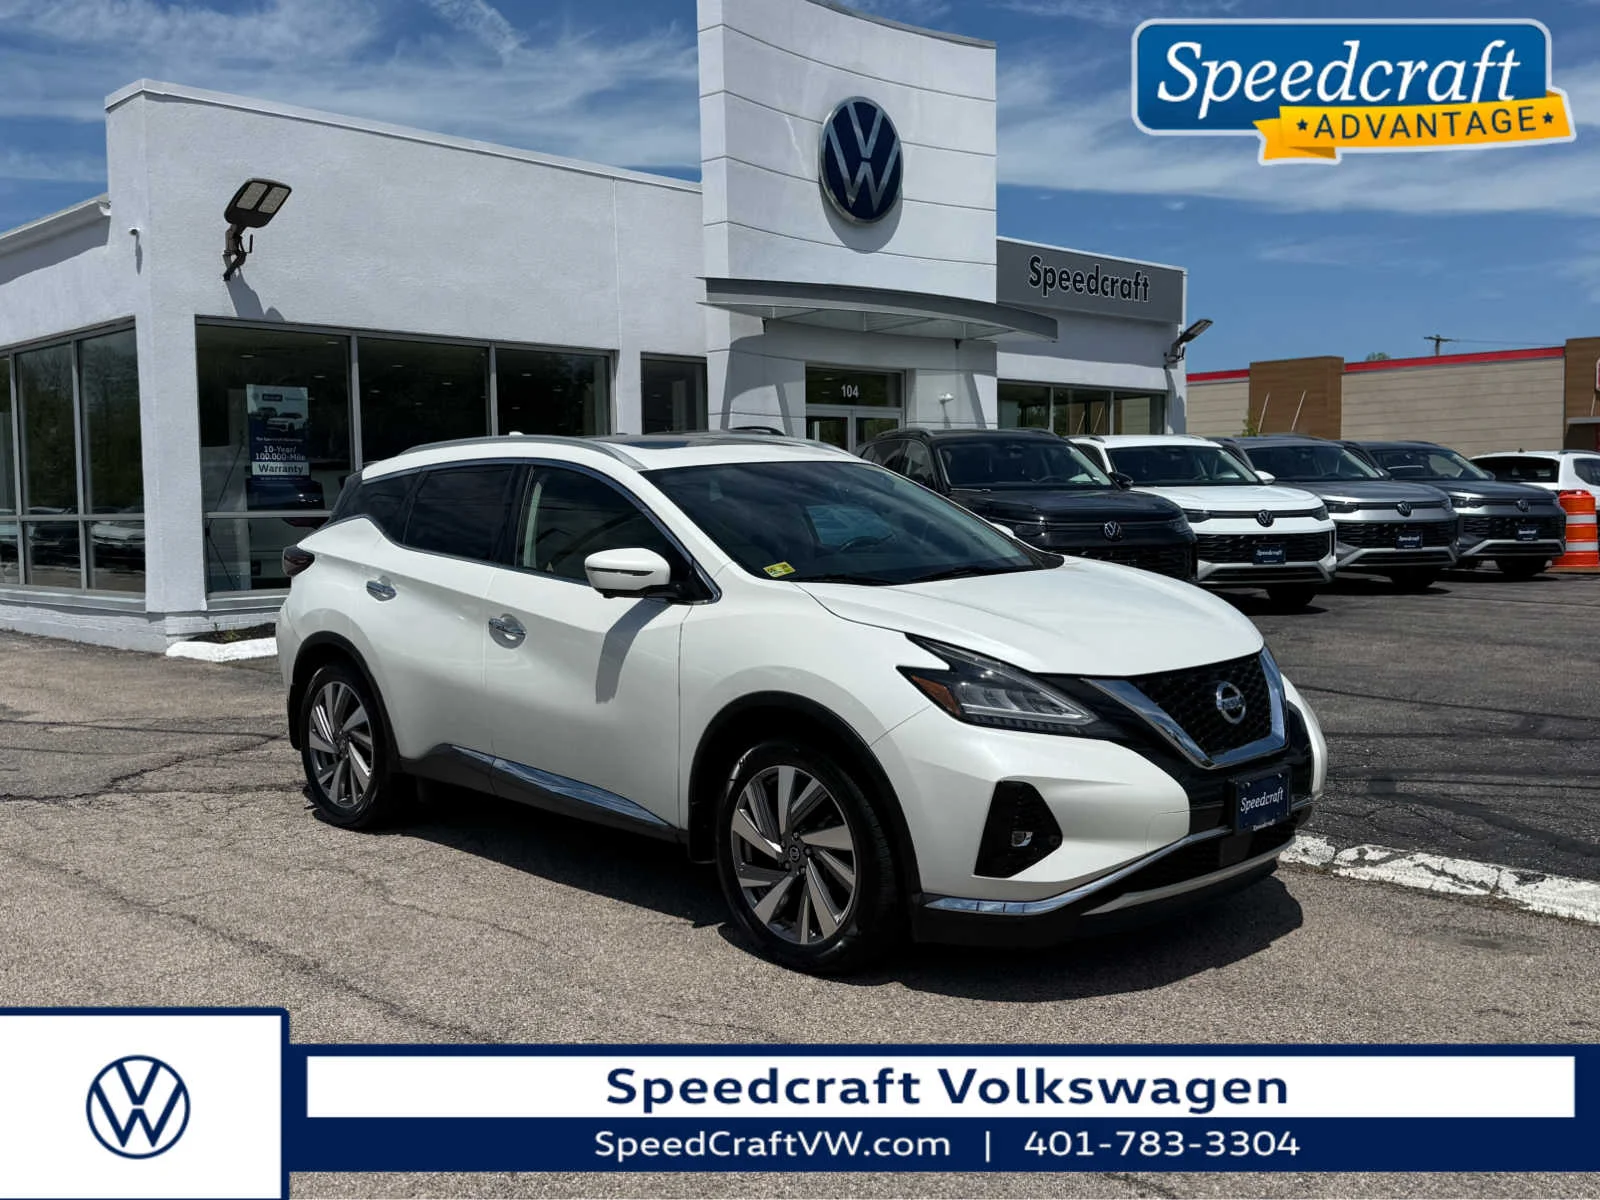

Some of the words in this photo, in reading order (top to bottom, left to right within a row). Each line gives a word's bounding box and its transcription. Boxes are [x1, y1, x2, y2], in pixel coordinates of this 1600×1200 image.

[1029, 255, 1149, 301] Speedcraft
[841, 384, 859, 398] 104
[259, 463, 303, 475] Warranty
[1240, 786, 1284, 814] Speedcraft
